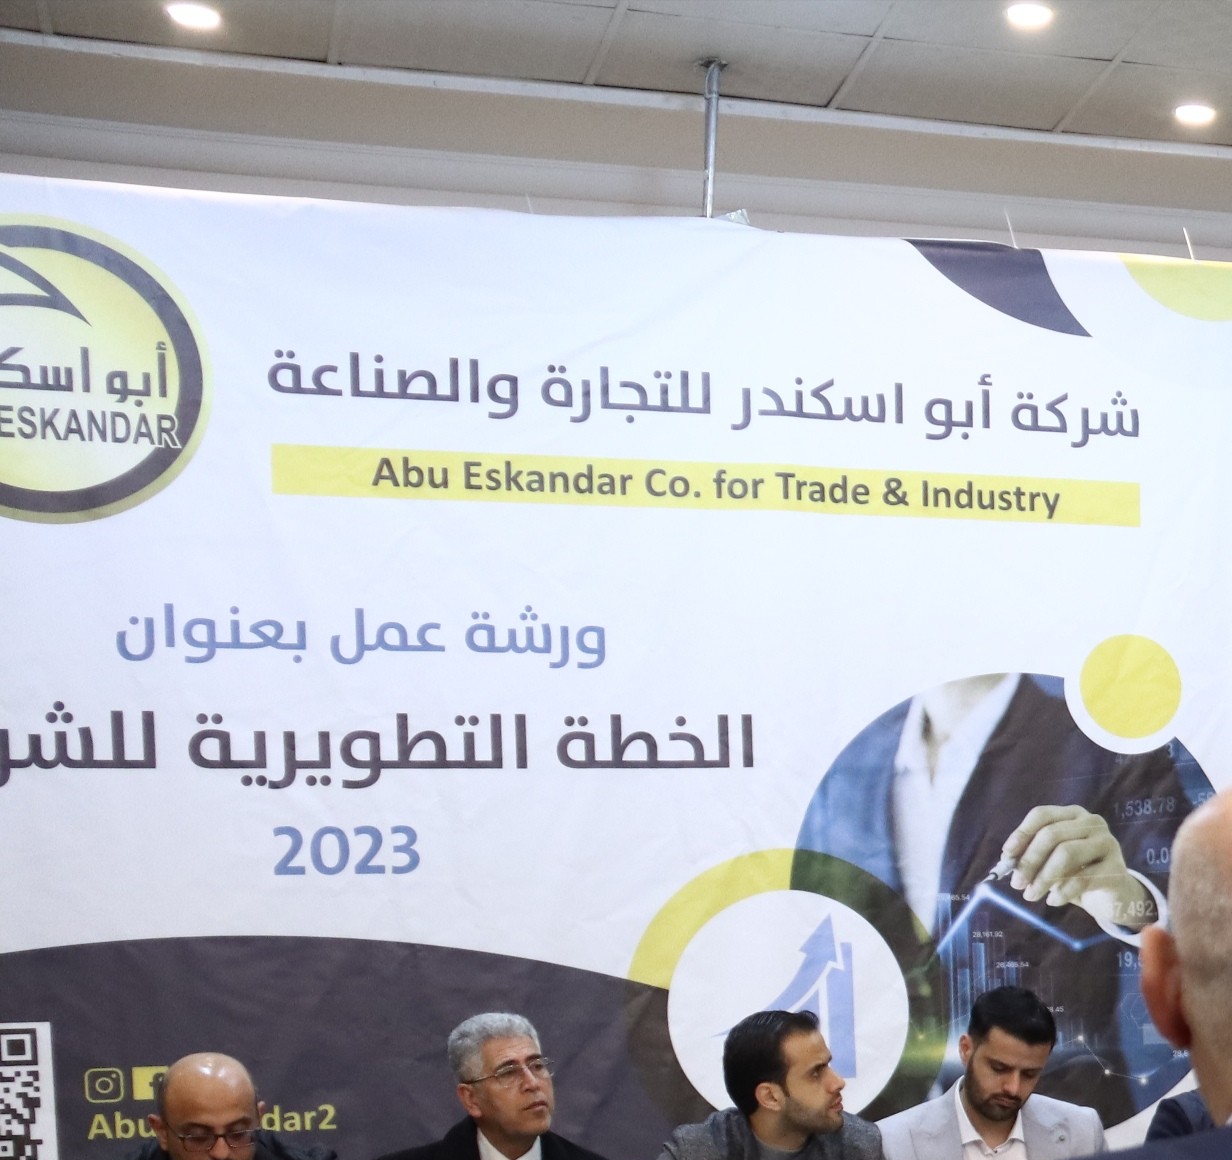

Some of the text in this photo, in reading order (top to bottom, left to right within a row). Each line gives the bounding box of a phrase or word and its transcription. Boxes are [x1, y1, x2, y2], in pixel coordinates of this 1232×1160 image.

[106, 340, 168, 408] أبو
[267, 349, 1140, 448] شركة أبو اسكندر للتجارة والصناعة
[371, 456, 1060, 520] Abu Eskandar Co. for Trade & Industry
[115, 603, 607, 670] ورشة عمل بعنوان
[188, 712, 528, 790] التطويرية
[556, 713, 754, 769] الخطة
[272, 825, 421, 876] 2023
